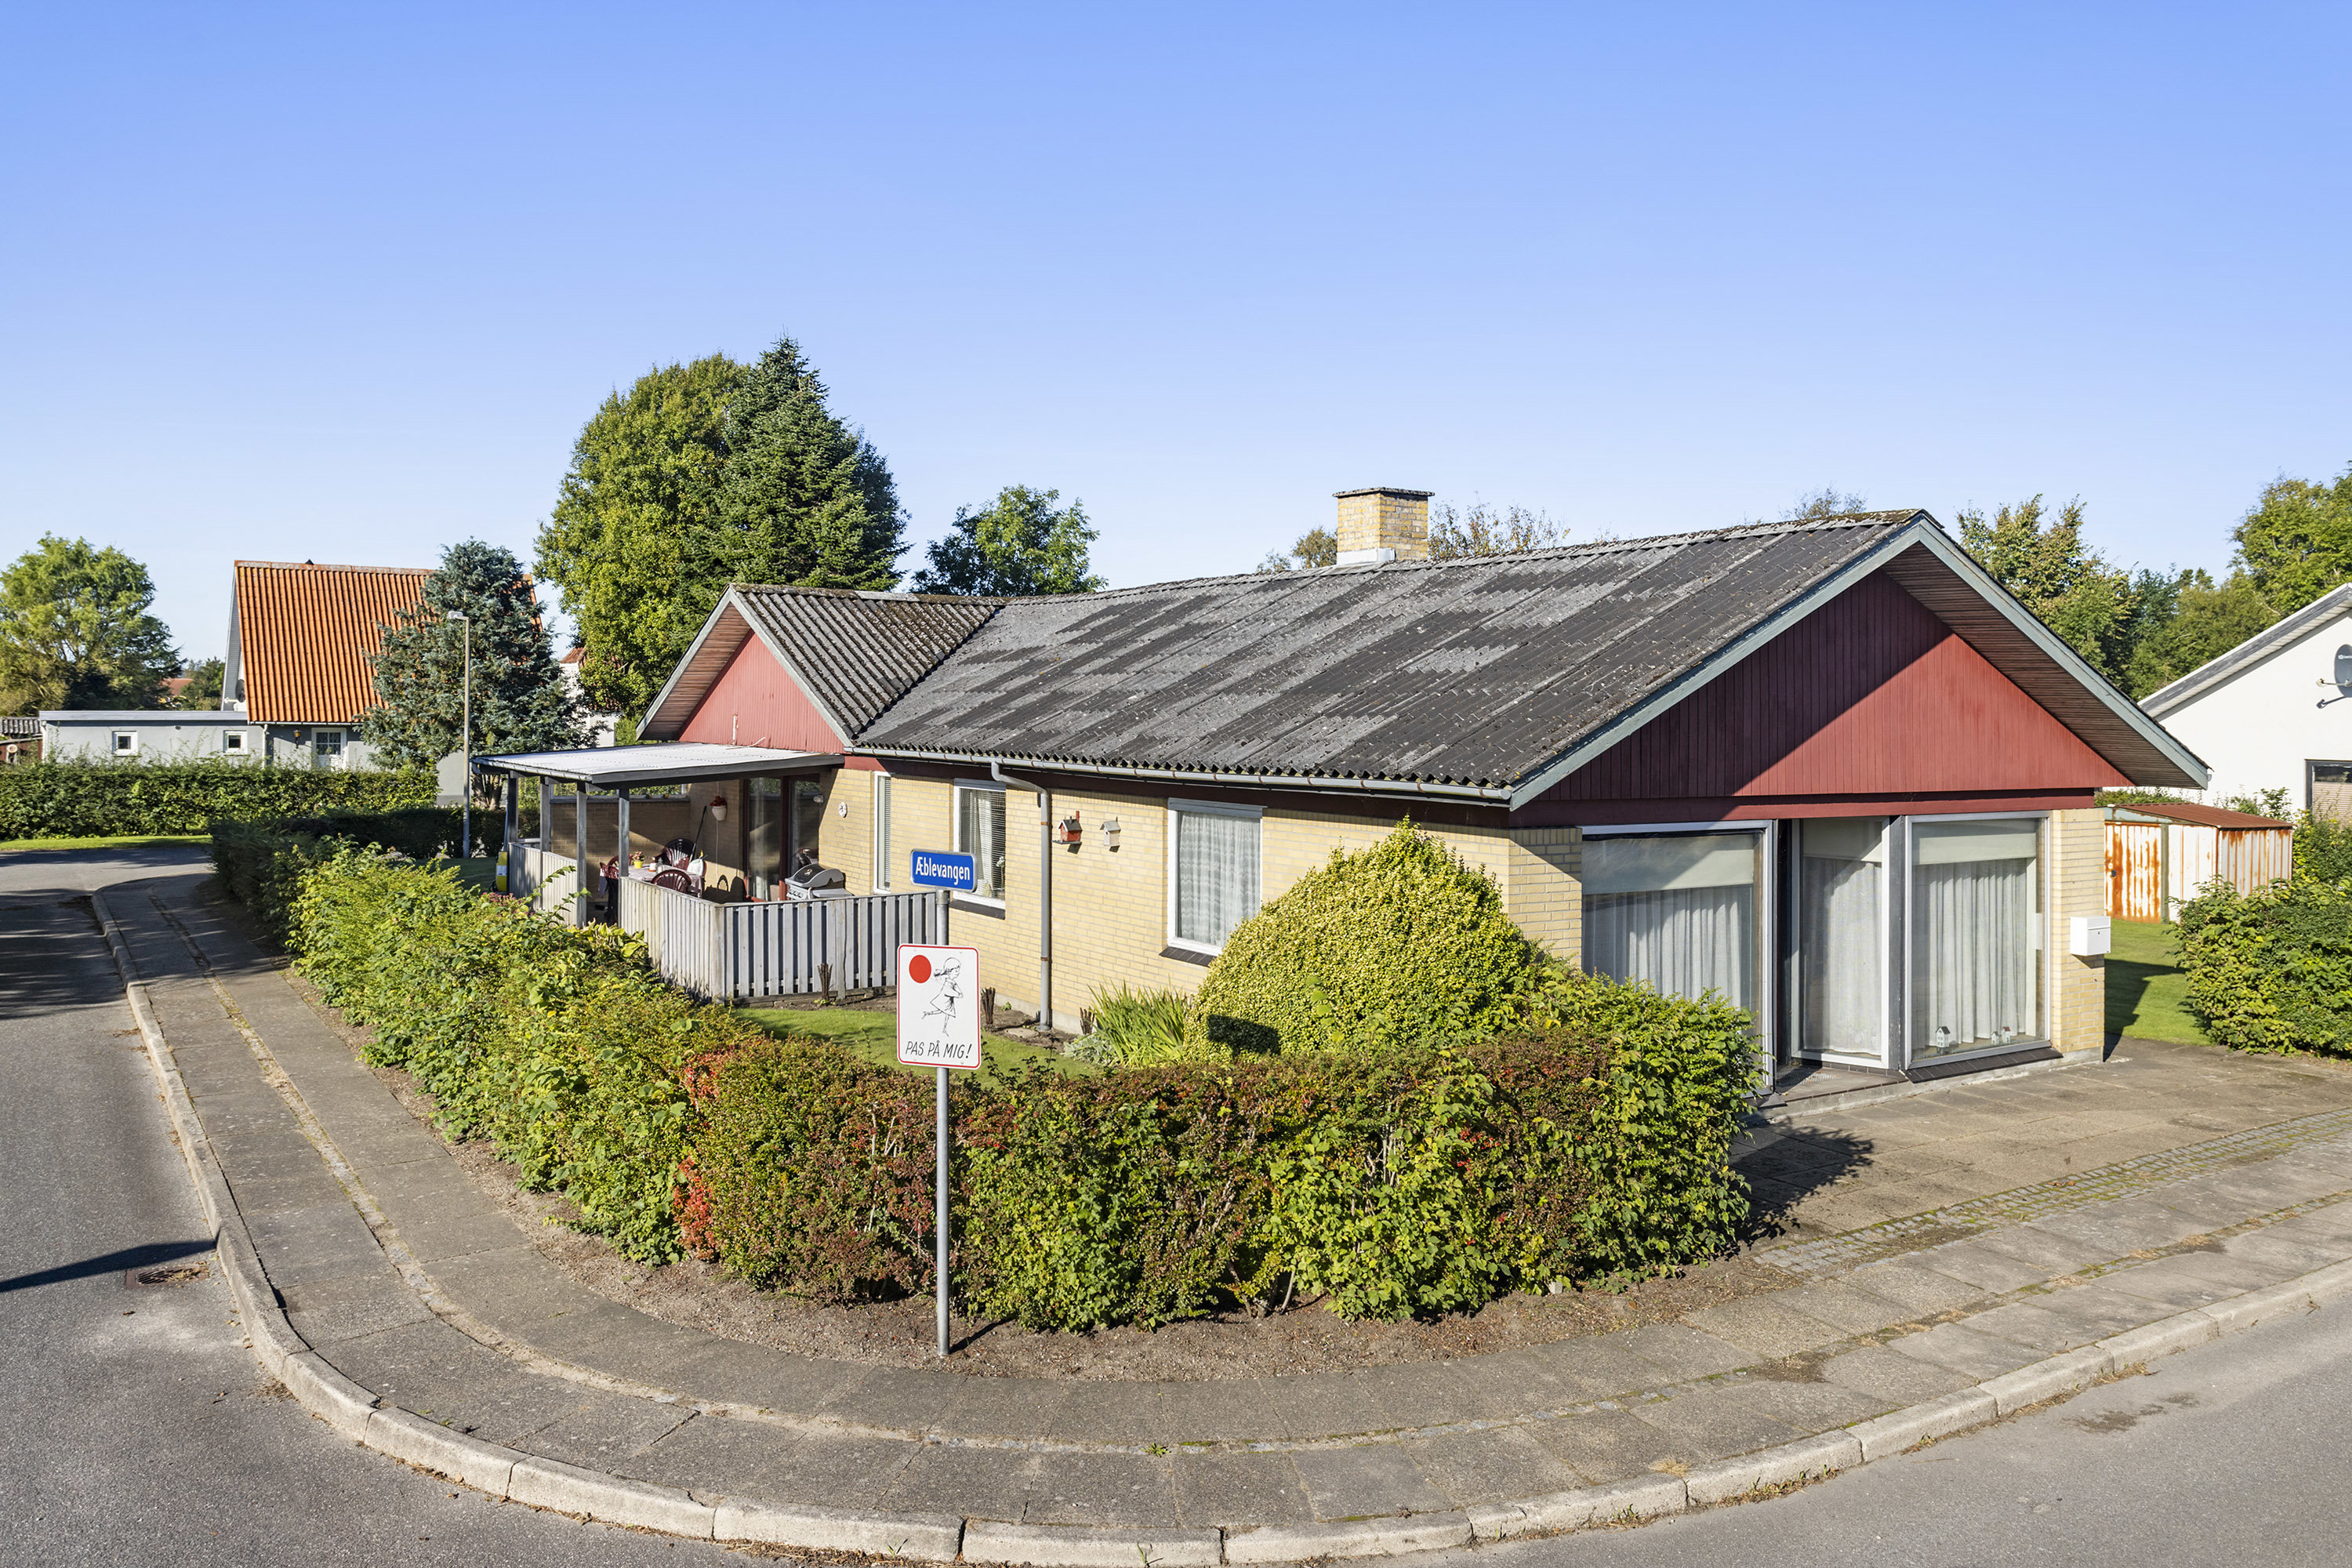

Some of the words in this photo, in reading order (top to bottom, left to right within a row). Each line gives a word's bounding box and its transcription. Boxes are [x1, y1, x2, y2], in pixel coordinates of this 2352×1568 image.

[915, 856, 971, 886] Æblevangen
[905, 1040, 925, 1056] PAS
[927, 1040, 940, 1058] PÅ
[942, 1043, 972, 1059] MIG!
